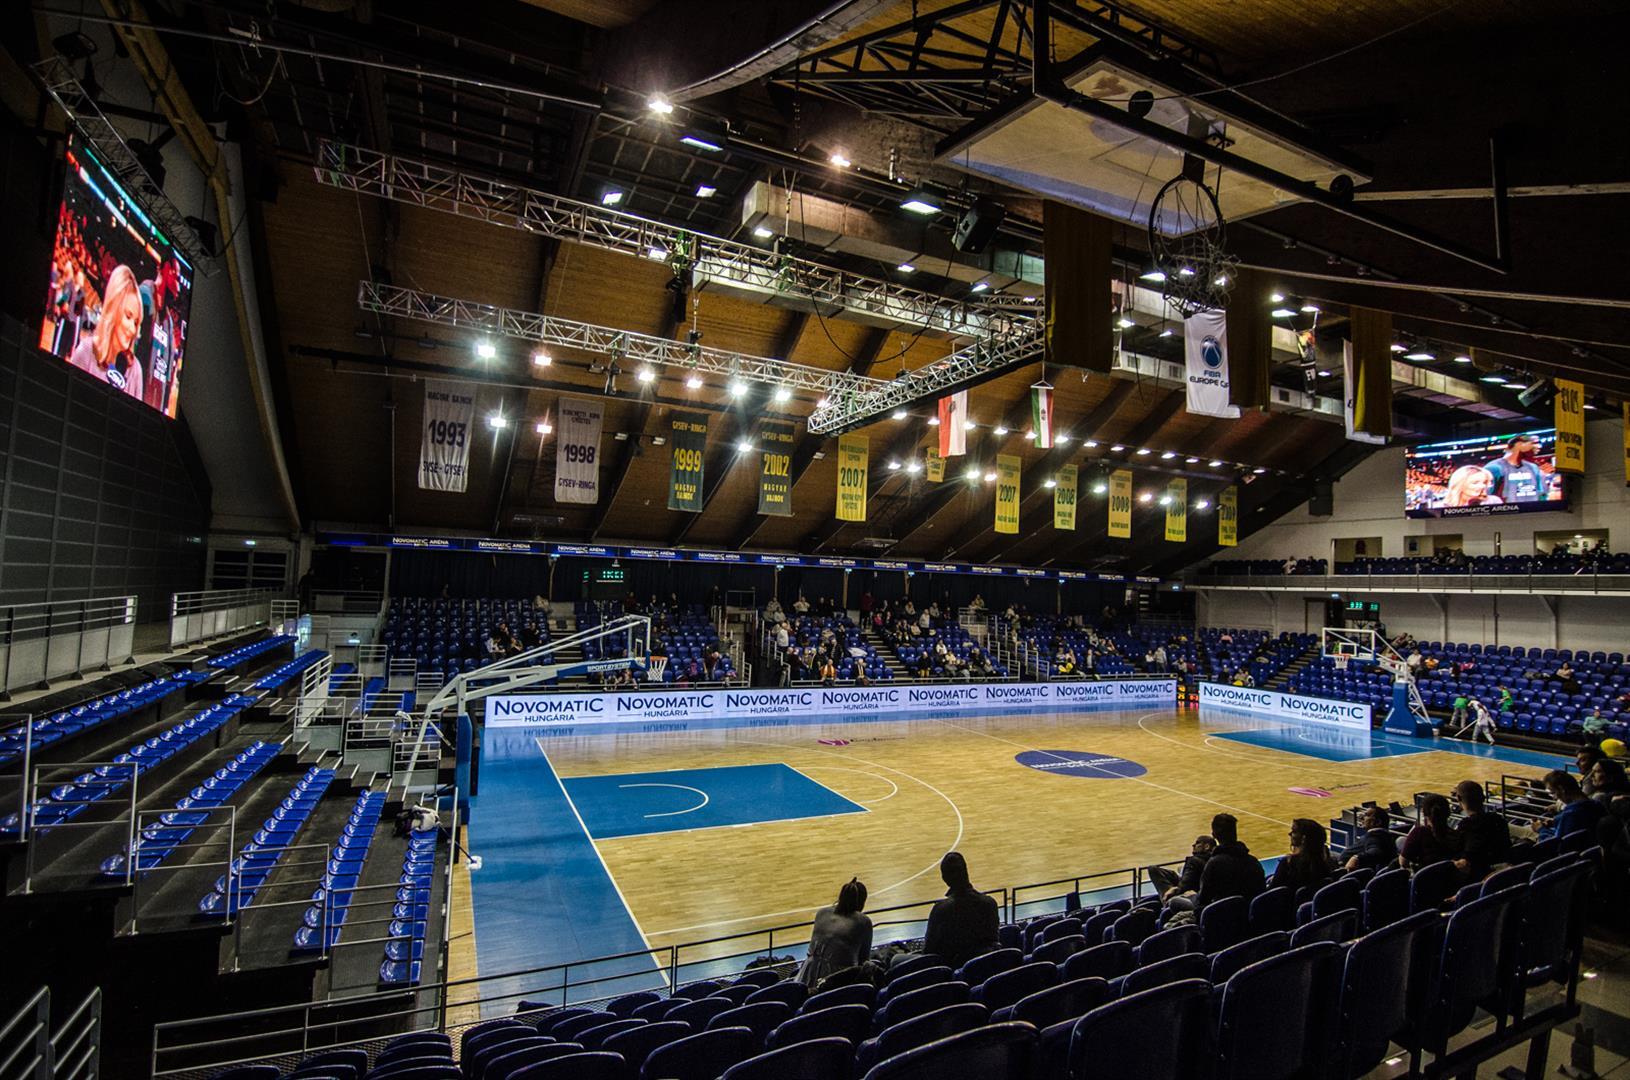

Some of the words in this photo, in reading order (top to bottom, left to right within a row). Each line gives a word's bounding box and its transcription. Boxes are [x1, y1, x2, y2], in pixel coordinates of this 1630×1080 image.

[429, 419, 466, 448] 1993
[564, 444, 595, 464] 1998
[673, 447, 702, 472] 1999
[763, 453, 790, 477] 2002
[840, 467, 865, 488] 2007
[1444, 506, 1490, 516] NOVOMATIC
[392, 537, 428, 546] NOVOMATIC
[909, 687, 978, 702] NOVOMATIC
[986, 686, 1049, 699] NOVOMATIC
[1056, 684, 1113, 697] NOVOMATIC
[1119, 683, 1173, 694] NOVOMATIC
[1203, 685, 1272, 706] NOVOMATIC
[617, 694, 714, 711] NOVOMATIC
[726, 692, 812, 708] NOVOMATIC
[822, 690, 899, 705] NOVOMATIC
[494, 698, 604, 716] NOVOMATIC
[644, 710, 688, 718] HUNGÁRIA
[750, 706, 790, 714] HUNGÁRIA
[1281, 696, 1364, 719] NOVOMATIC
[524, 714, 576, 722] HUNGÁRIA
